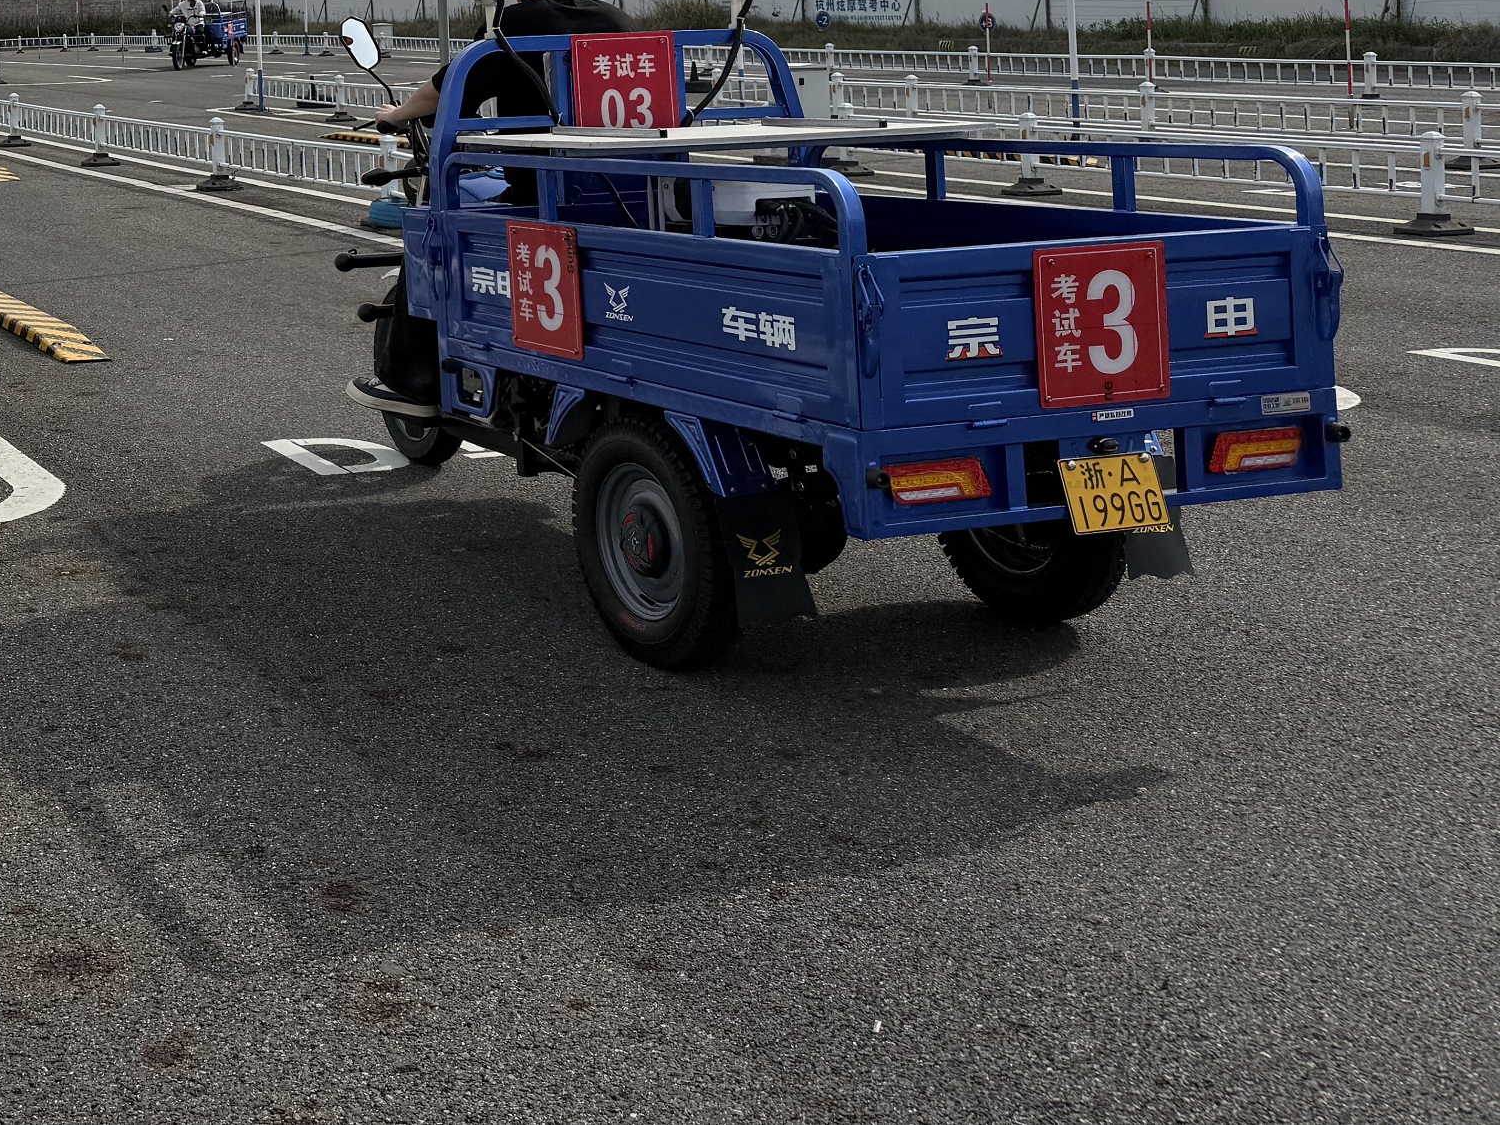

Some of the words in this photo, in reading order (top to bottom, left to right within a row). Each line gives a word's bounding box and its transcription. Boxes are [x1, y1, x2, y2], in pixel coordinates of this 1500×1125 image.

[592, 52, 657, 80] 考试车
[601, 87, 654, 129] 03
[516, 242, 534, 322] 考试车
[535, 244, 564, 331] 3
[721, 305, 797, 351] 车辆
[946, 316, 1001, 359] 宗
[1206, 295, 1256, 337] 申
[1050, 274, 1082, 373] 考试车
[1086, 269, 1139, 375] 3
[1079, 458, 1141, 490] 浙·A
[1078, 488, 1163, 530] 199GG
